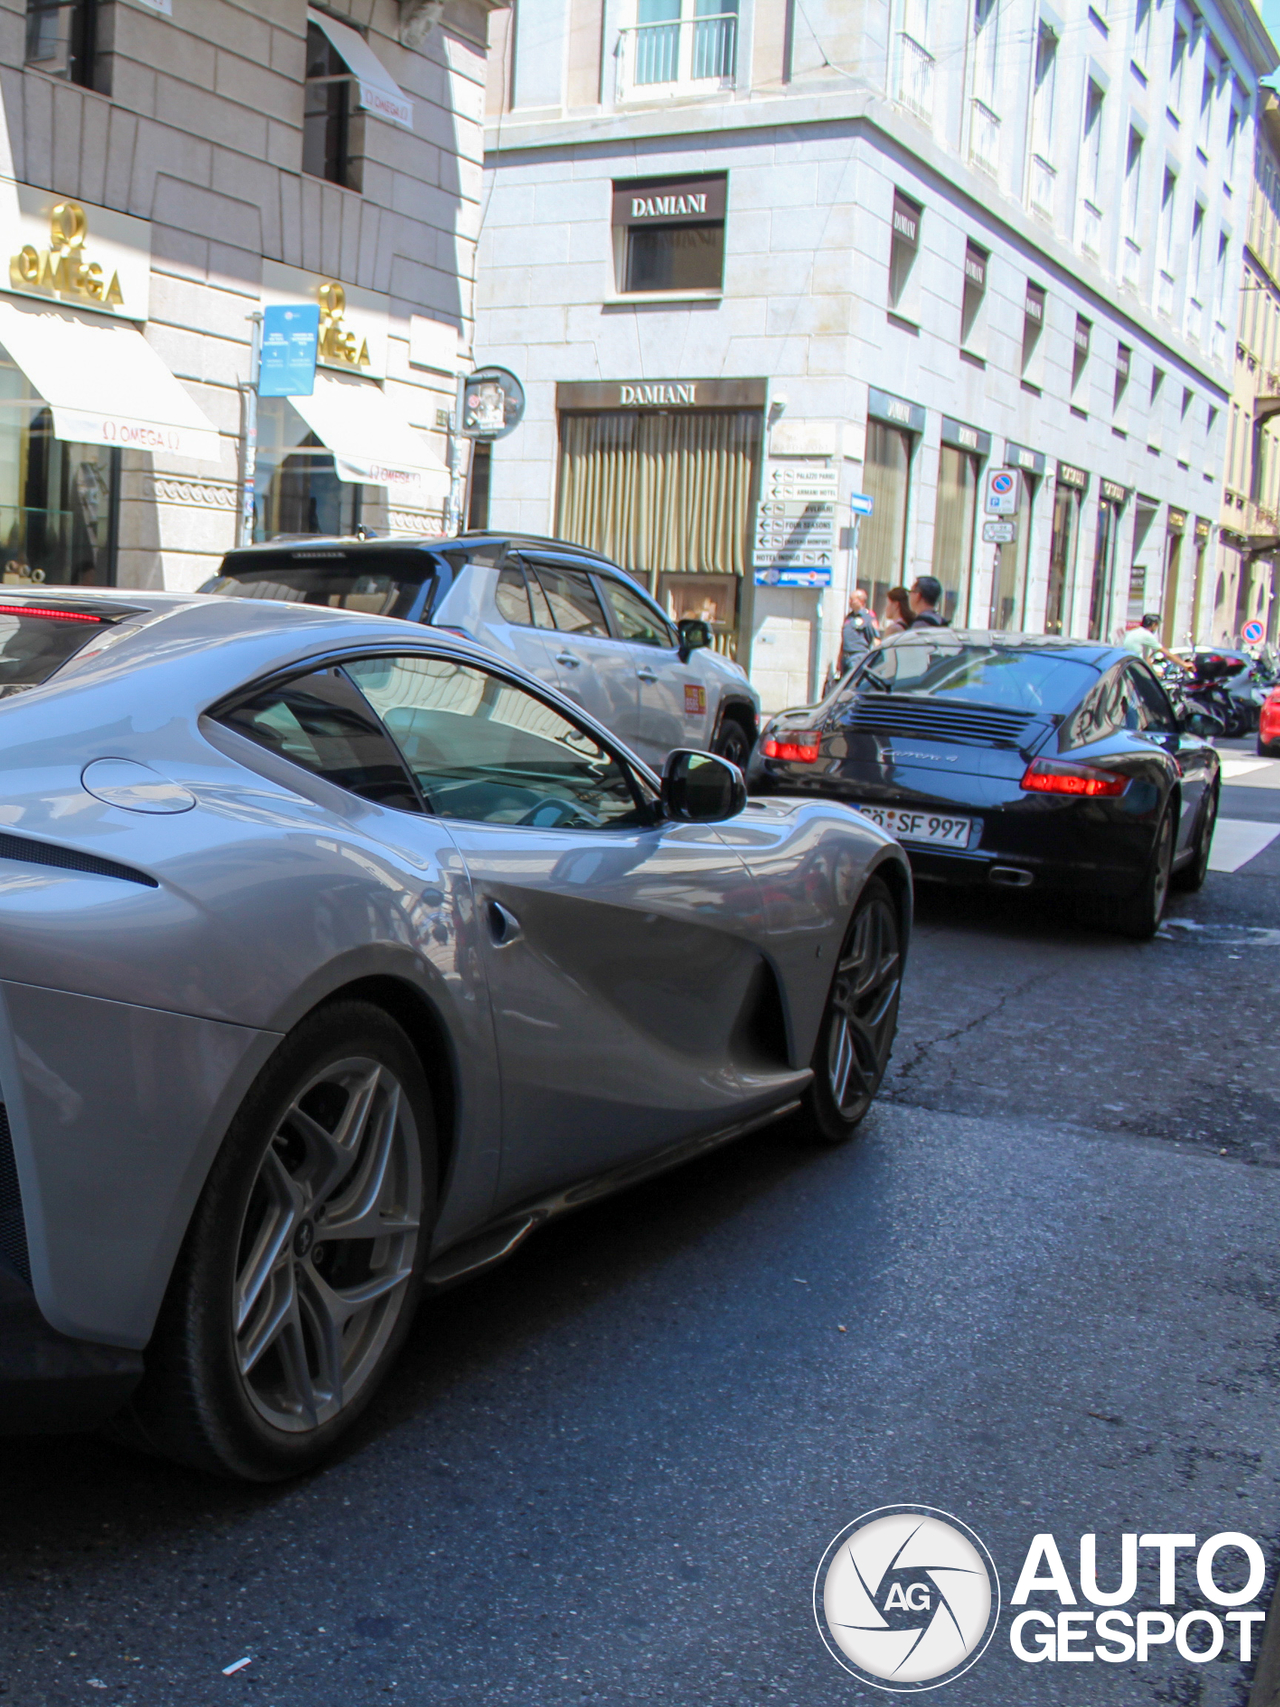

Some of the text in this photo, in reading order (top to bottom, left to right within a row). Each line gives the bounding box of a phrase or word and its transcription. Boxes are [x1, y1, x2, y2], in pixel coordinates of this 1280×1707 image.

[375, 96, 399, 116] OMEGA
[631, 193, 708, 217] DAMIANI
[894, 210, 916, 240] DAMIANI
[10, 244, 124, 304] OMEGA
[620, 384, 696, 405] DAMIANI
[120, 426, 164, 446] OMEGA
[819, 489, 836, 497] HOTEL
[785, 521, 831, 529] FOUR SEASONS
[756, 554, 777, 562] HOTEL
[897, 813, 925, 833] SF
[928, 817, 968, 840] 997
